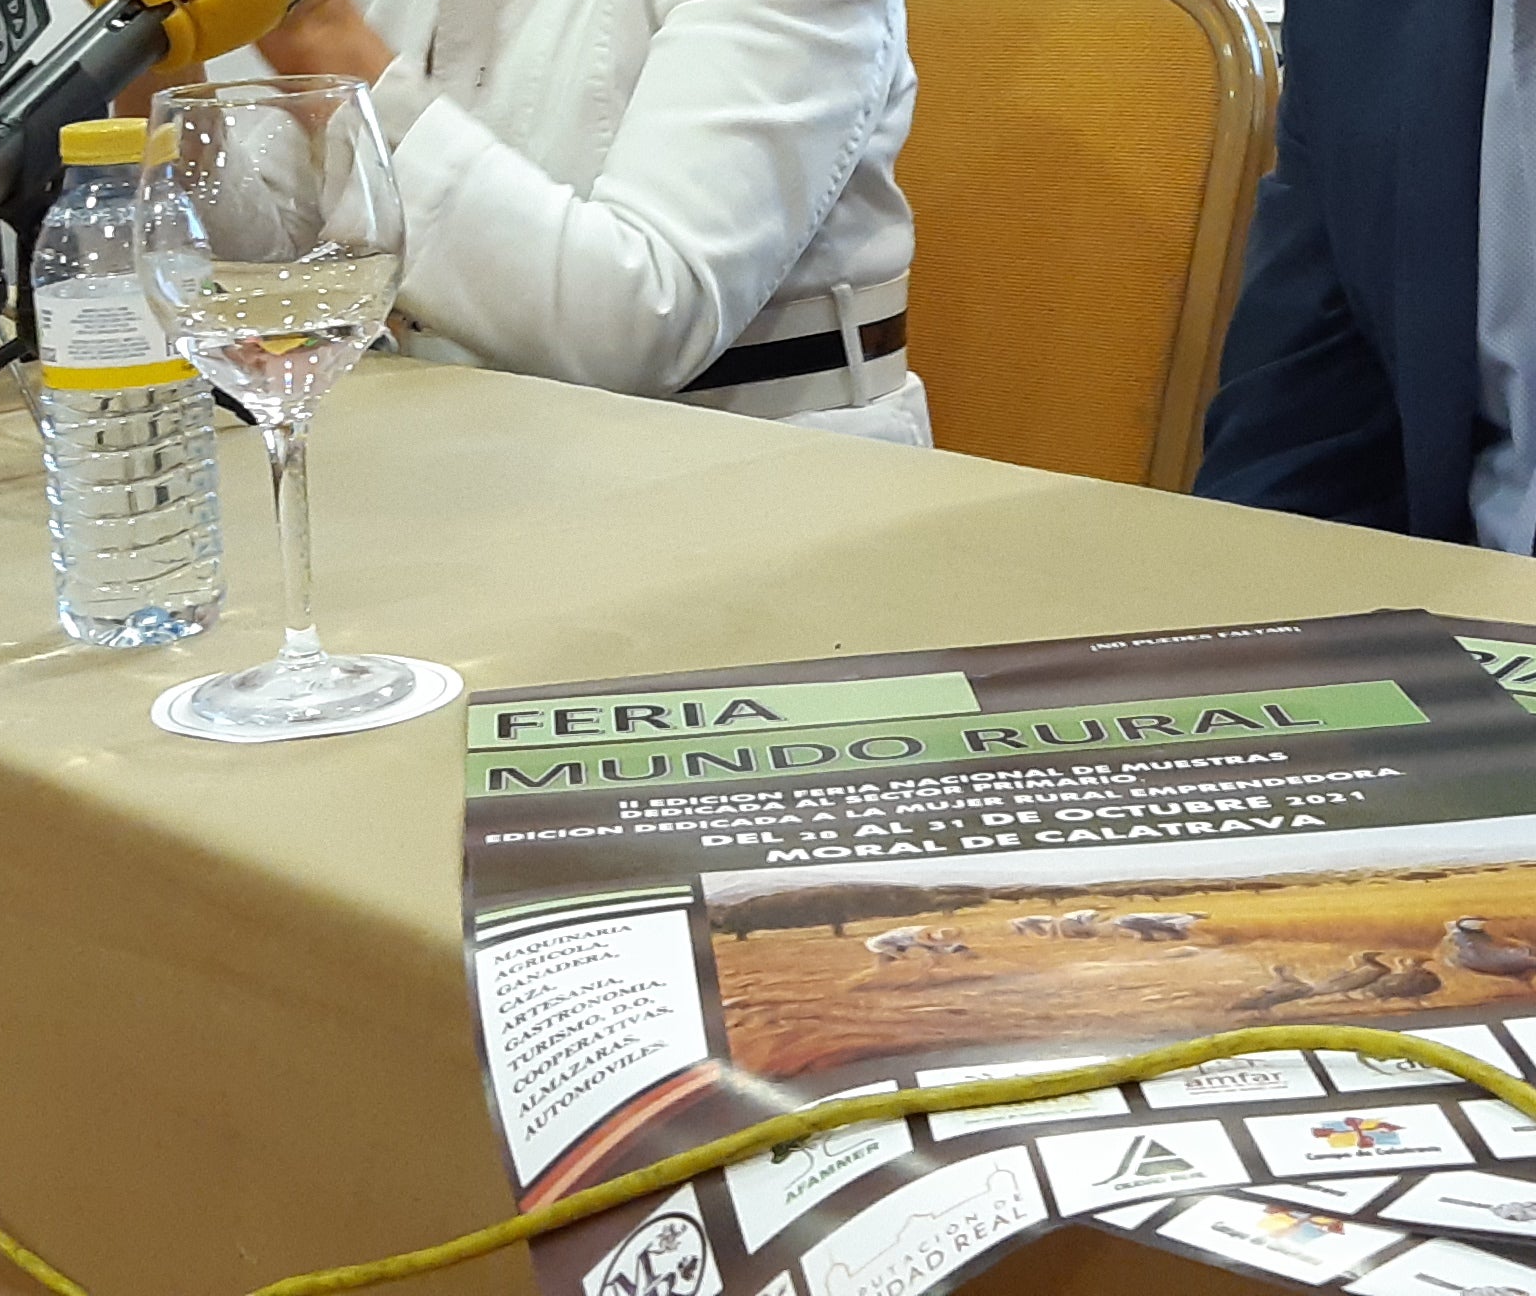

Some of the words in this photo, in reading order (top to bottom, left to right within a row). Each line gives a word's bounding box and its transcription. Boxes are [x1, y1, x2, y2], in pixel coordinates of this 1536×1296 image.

[496, 697, 788, 741] FERIA
[486, 735, 926, 792] MUNDO
[961, 703, 1325, 754] RURAL
[619, 801, 786, 820] DEDICADA
[795, 796, 836, 808] AL
[844, 784, 964, 805] SECTOR
[649, 791, 784, 808] EDICION
[793, 783, 881, 798] FERIA
[888, 767, 1065, 791] NACIONAL
[1071, 764, 1112, 776] DE
[1121, 751, 1290, 773] MUESTRAS
[484, 824, 624, 845] EDICION
[634, 814, 803, 835] DEDICADA
[811, 811, 837, 822] A
[845, 806, 887, 819] LA
[895, 796, 1005, 814] MUJER
[1013, 787, 1123, 805] RURAL
[1130, 766, 1404, 798] EMPRENDEDORA
[700, 831, 785, 848] DEL
[853, 821, 914, 837] AL
[928, 818, 965, 832] 31
[980, 810, 1042, 828] DE
[1054, 795, 1273, 822] OCTUBRE
[1285, 789, 1366, 807] 2021
[765, 840, 948, 864] MORAL
[960, 832, 1021, 851] DE
[1034, 813, 1327, 844] CALATRAVA
[493, 925, 633, 965] MAQUINARIA
[1185, 1071, 1282, 1088] amfar
[954, 1206, 1029, 1253] REAL
